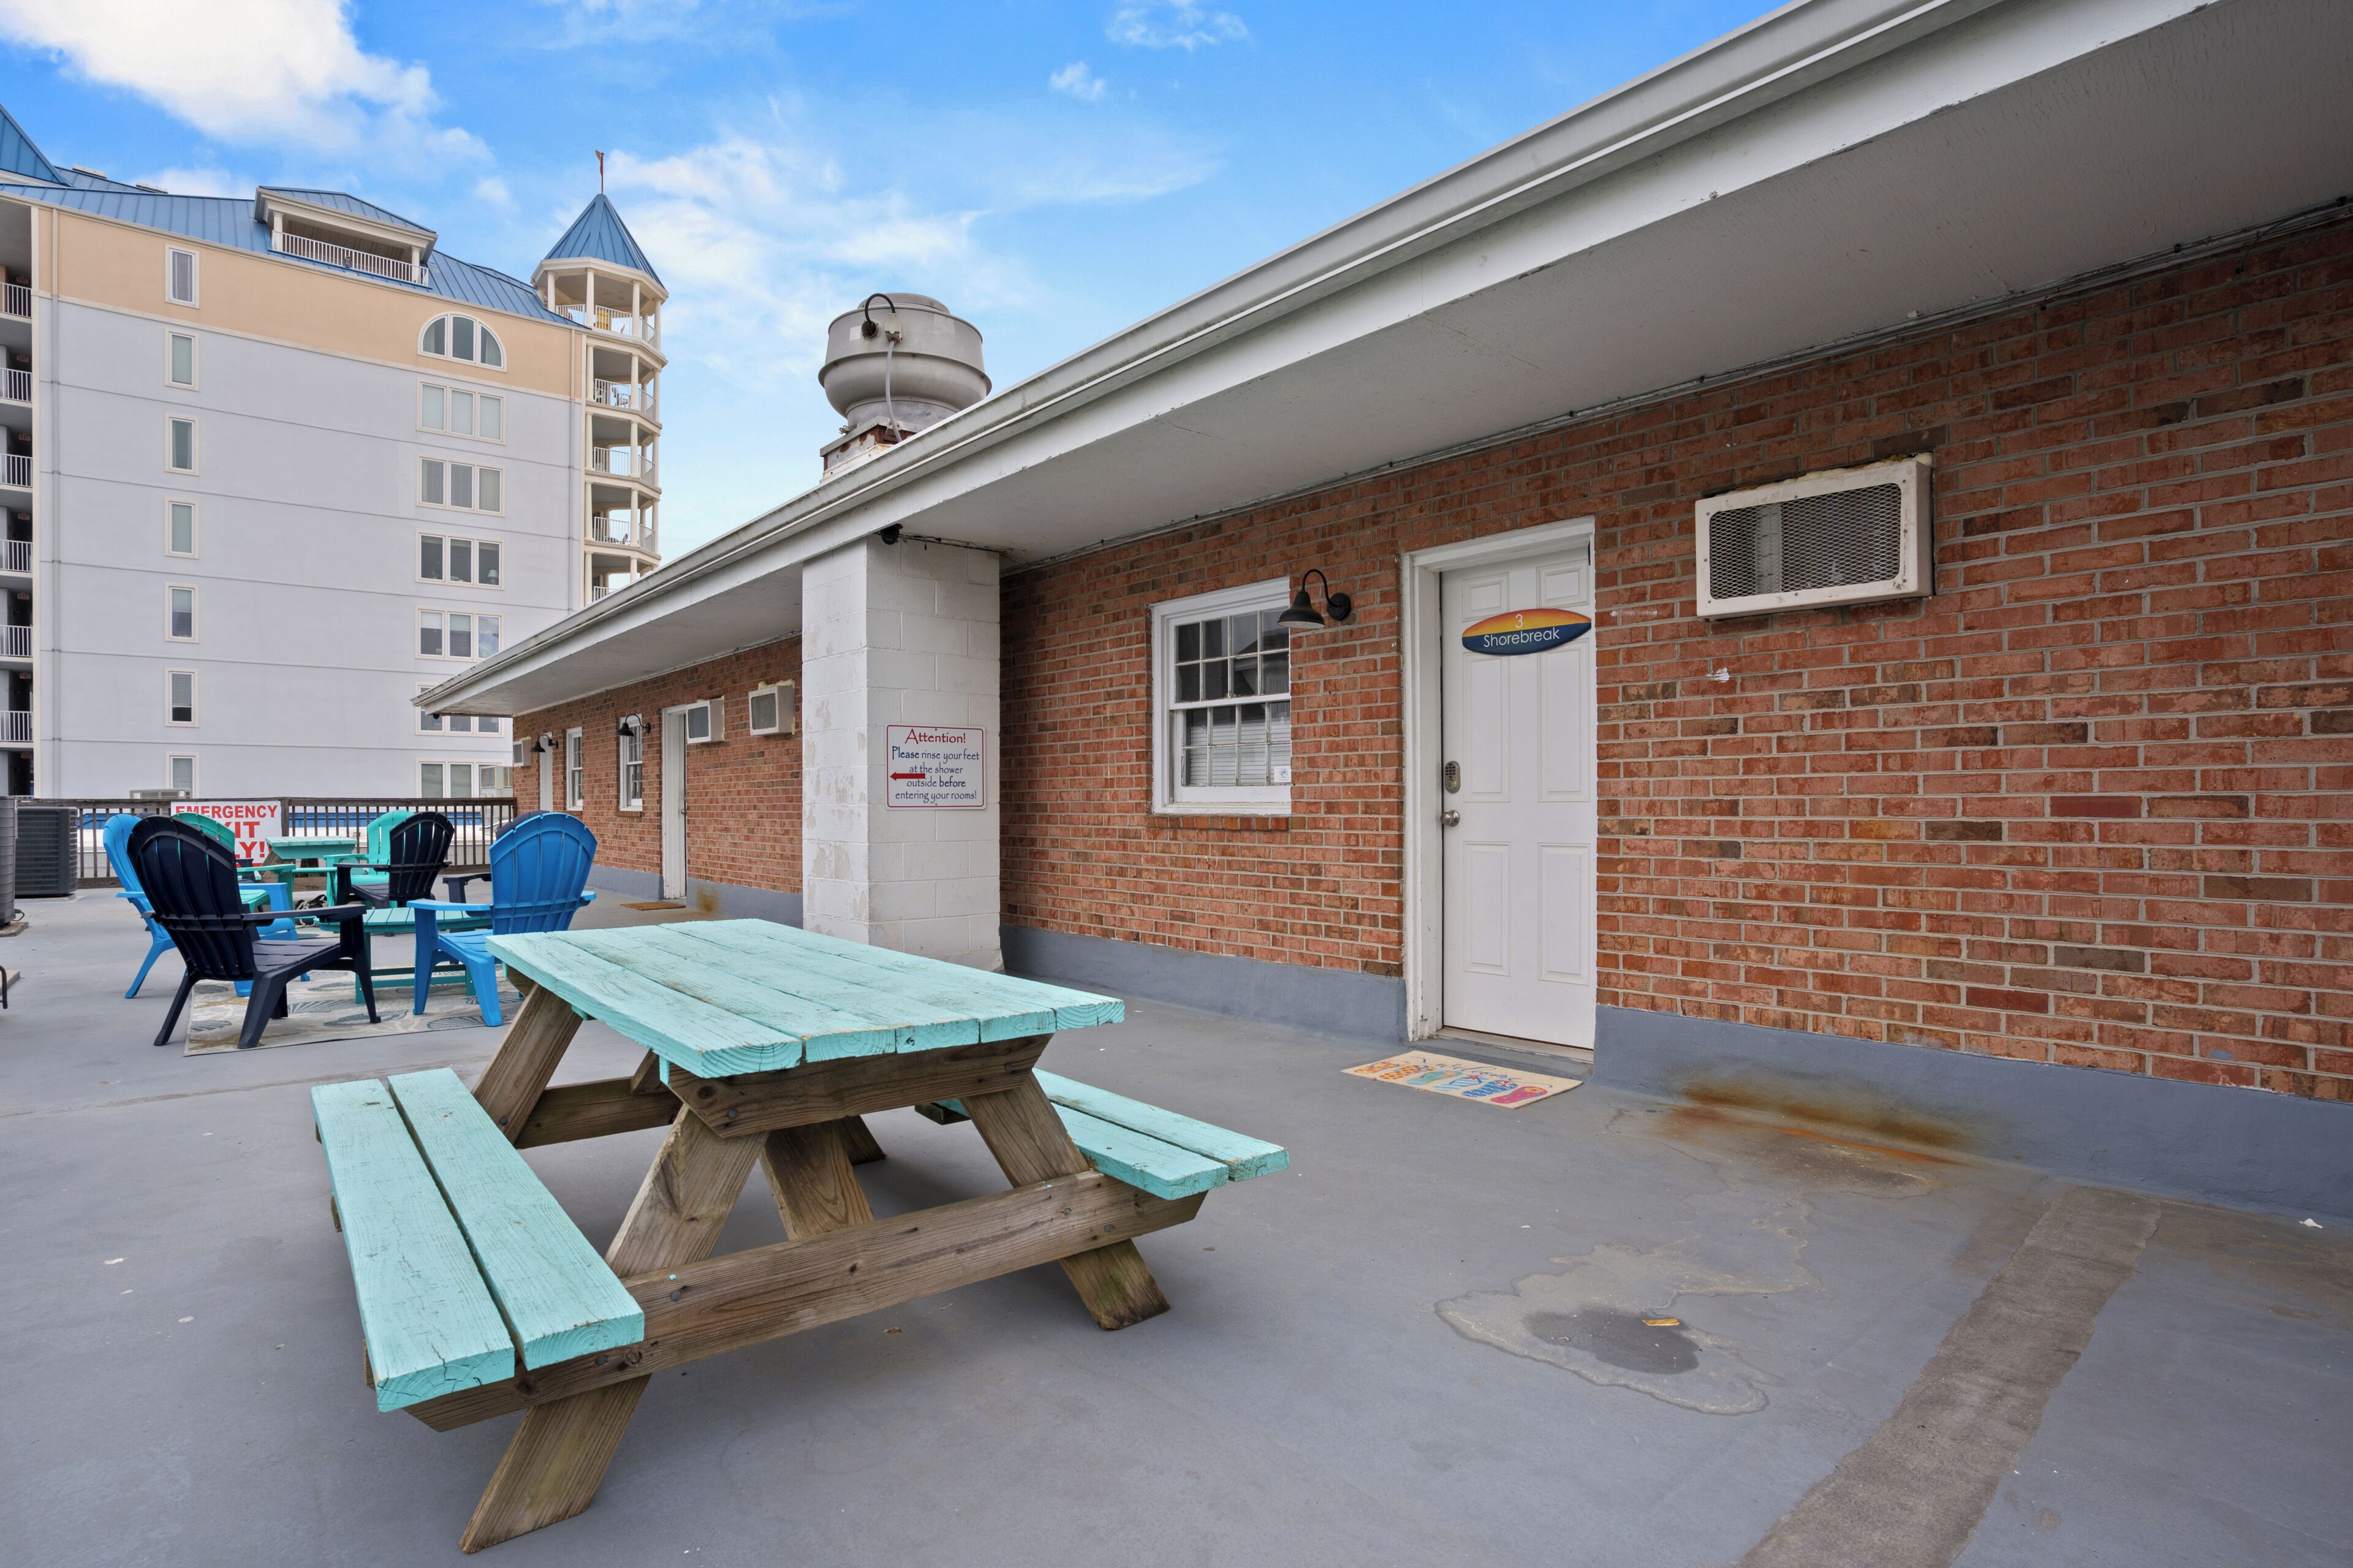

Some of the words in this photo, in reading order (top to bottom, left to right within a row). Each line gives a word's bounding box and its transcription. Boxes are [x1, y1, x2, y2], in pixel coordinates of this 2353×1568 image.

[1515, 613, 1523, 629] 3
[1483, 626, 1560, 648] Shorebreak
[904, 729, 966, 744] Attention!
[892, 746, 920, 760] Please
[921, 749, 941, 759] rinse
[943, 751, 962, 763] your
[963, 748, 980, 760] feet
[919, 762, 933, 773] the
[934, 762, 963, 773] shower
[907, 776, 937, 787] outside
[939, 776, 966, 787] before
[895, 790, 929, 803] entering
[931, 792, 950, 804] your
[951, 790, 977, 800] rooms!
[175, 805, 278, 818] EMERGENCY
